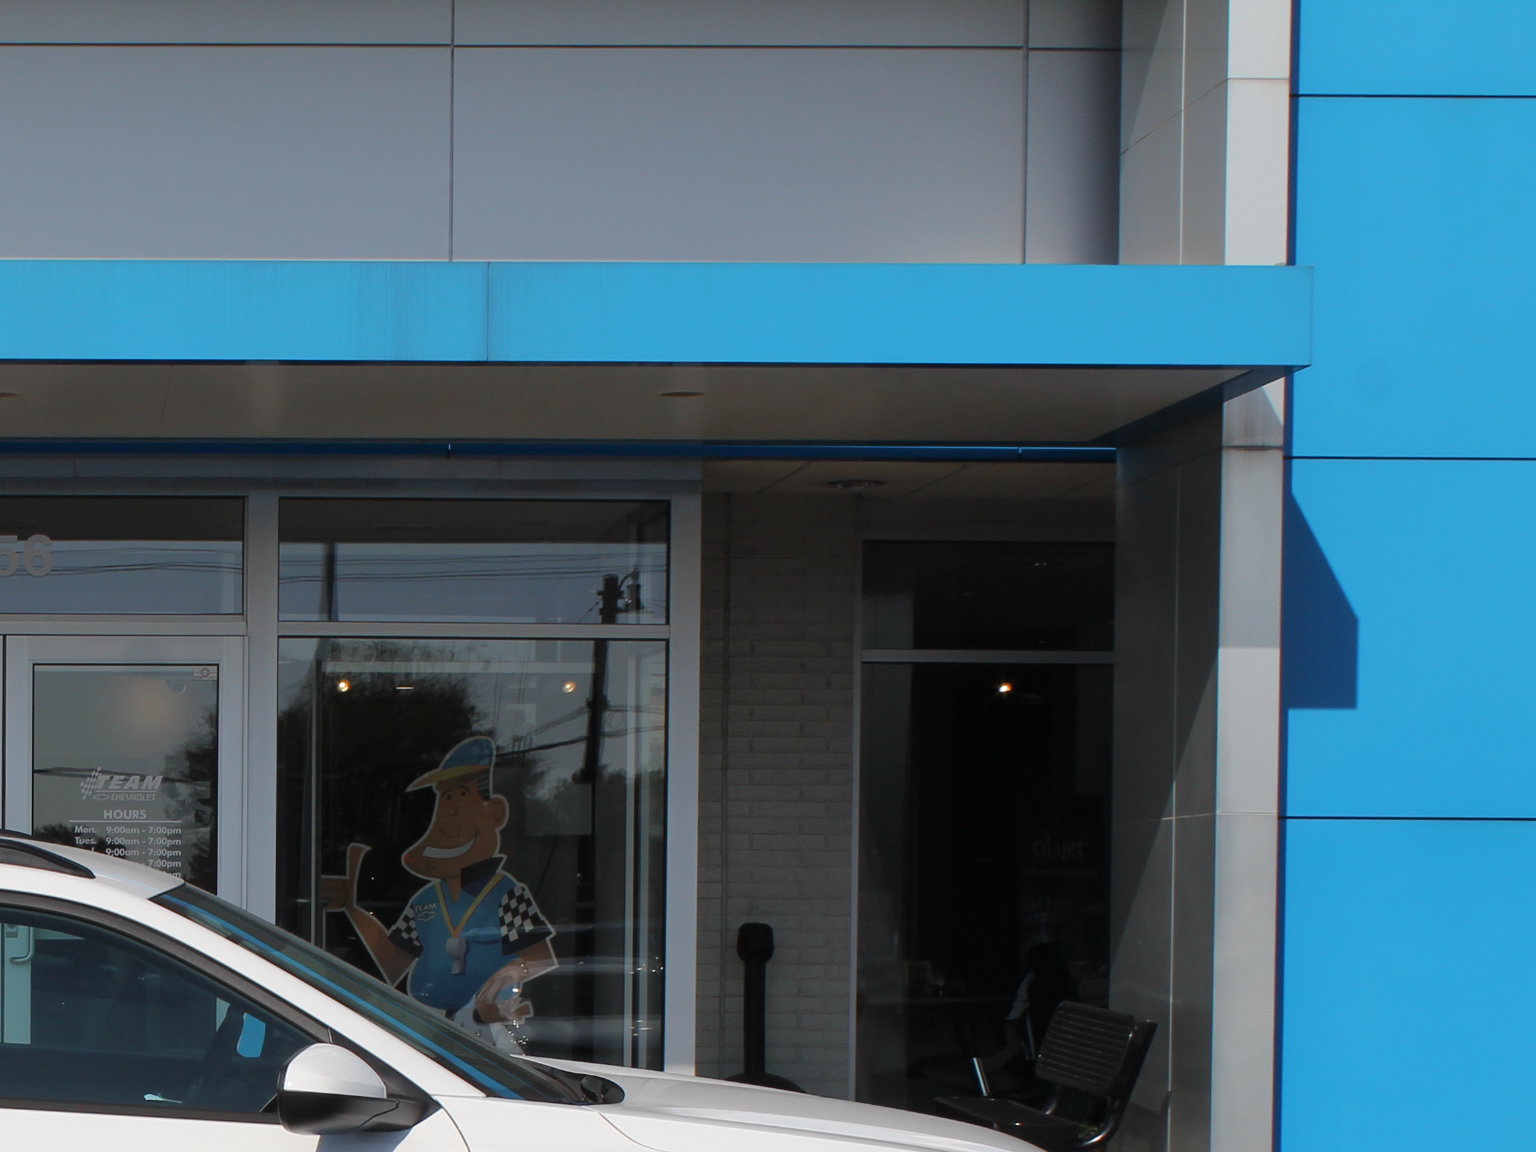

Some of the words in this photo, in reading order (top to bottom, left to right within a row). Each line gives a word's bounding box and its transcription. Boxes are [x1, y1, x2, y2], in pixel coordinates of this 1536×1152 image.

[96, 775, 164, 790] TEAM
[111, 793, 157, 801] CHEVROLET
[103, 809, 147, 820] HOURS
[74, 825, 97, 834] Mon.
[105, 826, 140, 834] 9:00am
[148, 826, 181, 836] 7:00pm
[74, 837, 97, 845] Tues.
[148, 838, 181, 847] 7:00pm
[105, 849, 140, 857] 9:00am
[148, 849, 181, 858] 7:00pm
[148, 860, 181, 870] 7:00pm
[414, 903, 437, 912] TEAM
